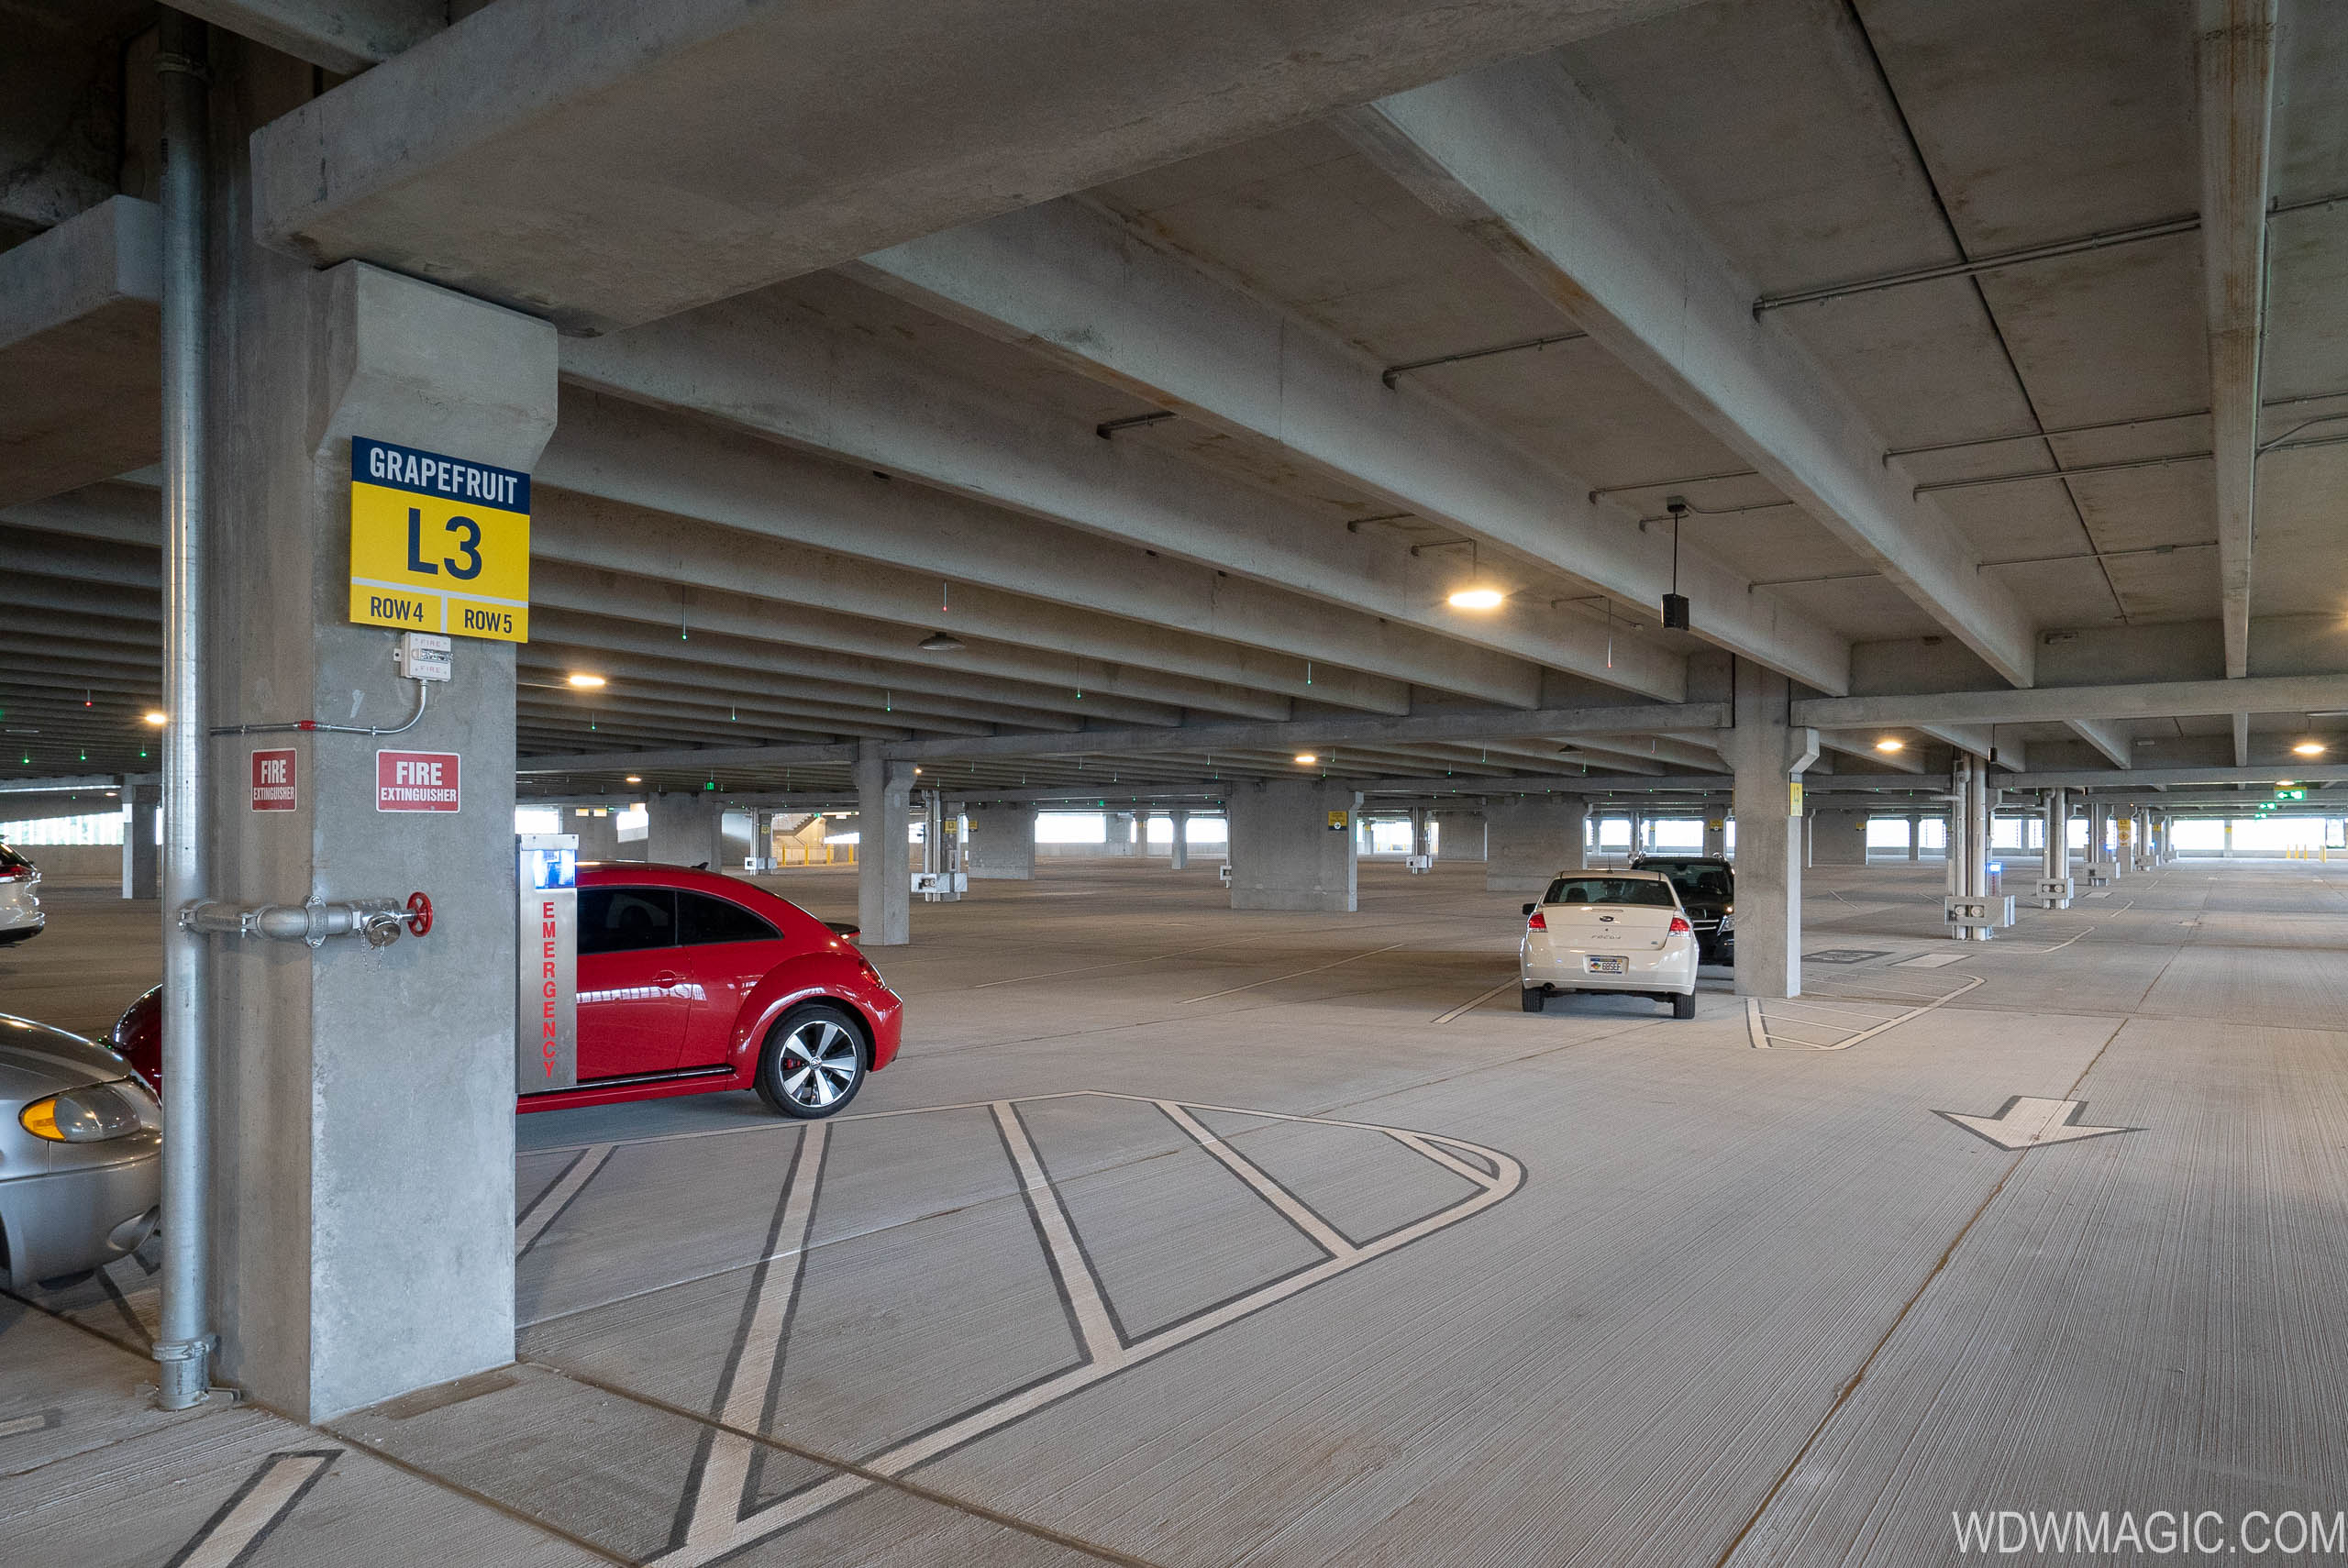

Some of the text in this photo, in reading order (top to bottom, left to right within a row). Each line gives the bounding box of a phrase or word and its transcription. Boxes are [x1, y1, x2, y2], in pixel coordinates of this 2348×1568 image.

[370, 447, 518, 504] GRAPEFRUIT
[407, 506, 482, 580] L3
[370, 596, 424, 623] ROW 4
[464, 608, 513, 634] ROW 5
[420, 637, 441, 647] FIRE
[420, 665, 441, 674] FIRE
[260, 759, 287, 785] FIRE
[396, 761, 443, 786] FIRE
[253, 786, 294, 801] EXTINGUISHER
[381, 787, 457, 803] EXTINGUISHER
[542, 901, 557, 1078] EMERGENCY
